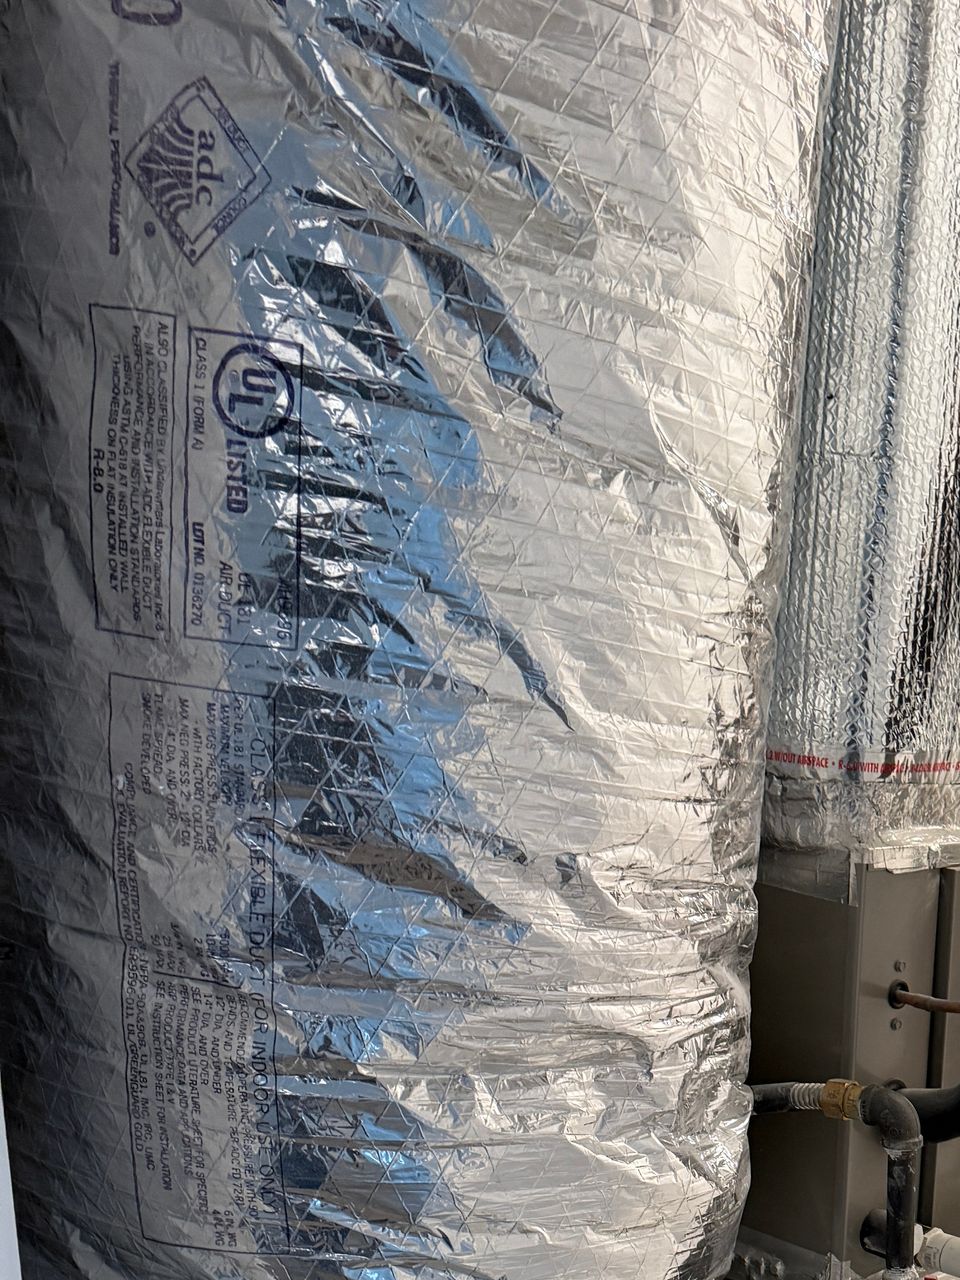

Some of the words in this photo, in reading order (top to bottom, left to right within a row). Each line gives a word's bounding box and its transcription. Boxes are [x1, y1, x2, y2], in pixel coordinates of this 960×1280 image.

[196, 130, 224, 207] adc
[144, 343, 154, 355] IN
[157, 321, 169, 356] ALSO
[195, 337, 207, 379] CLASS
[108, 354, 120, 424] THICKNESS
[123, 355, 133, 395] USING
[132, 325, 144, 426] PERFORMANCE
[228, 368, 276, 414] UL
[144, 358, 156, 448] ACCORDANCE
[156, 360, 169, 435] CLASSIFIED
[121, 400, 131, 433] ASTM
[192, 395, 205, 434] (FORM
[107, 428, 117, 447] ON
[119, 437, 130, 469] C-518
[131, 429, 142, 455] AND
[156, 439, 166, 453] BY
[191, 437, 205, 451] A)
[93, 448, 105, 493] R-8.0
[107, 450, 117, 479] FLAT
[119, 473, 128, 487] AT
[143, 453, 153, 484] WITH
[226, 438, 248, 514] LISTED
[130, 458, 140, 543] INSTALLATION
[142, 487, 153, 512] ADC
[106, 483, 117, 555] INSULATION
[118, 491, 129, 558] INSTALLED
[192, 521, 205, 546] LOT
[141, 516, 153, 573] FLEXIBLE
[108, 559, 119, 592] ONLY
[120, 561, 129, 594] WALL
[130, 548, 141, 623] STANDARDS
[219, 560, 233, 585] AIR
[142, 576, 153, 611] DUCT
[191, 572, 205, 626] 0136270
[217, 591, 233, 635] DUCT
[141, 692, 152, 729] SMOKE
[153, 694, 164, 731] FLAME
[179, 723, 189, 746] NEG
[192, 727, 202, 753] WITH
[140, 733, 152, 795] DEVELOPED
[193, 756, 204, 801] FACTORY
[250, 738, 266, 806] CLASS
[775, 751, 796, 764] W/OUT
[797, 755, 829, 769] AIRSPACE
[860, 762, 879, 774] WITH
[166, 769, 176, 790] AND
[124, 762, 137, 838] COMPLIANCE
[116, 803, 129, 873] EVALUATION
[192, 804, 204, 851] COLLARS
[127, 841, 137, 867] AND
[118, 876, 130, 920] REPORT
[139, 959, 149, 989] NFPA
[249, 931, 266, 986] DUCT
[155, 979, 165, 999] SEE
[191, 986, 201, 1003] SEE
[175, 983, 189, 1057] PERFORMANCE
[225, 994, 236, 1026] BENDS
[248, 992, 269, 1034] (FOR
[152, 1002, 164, 1070] INSTRUCTION
[164, 1004, 176, 1053] PRODUCT
[187, 1007, 200, 1056] PRODUCT
[199, 1034, 210, 1056] AND
[223, 1029, 234, 1051] AND
[139, 1054, 148, 1067] UL
[211, 1036, 221, 1058] AND
[154, 1072, 164, 1102] SHEET
[177, 1061, 188, 1085] DATA
[188, 1059, 201, 1114] LITERATURE
[199, 1059, 210, 1085] OVER
[212, 1060, 223, 1094] UNDER
[252, 1040, 269, 1115] INDOOR
[157, 1105, 167, 1124] FOR
[179, 1088, 189, 1109] AND
[134, 1121, 144, 1152] GOLD
[191, 1118, 203, 1147] SHEET
[230, 1126, 240, 1143] PER
[256, 1121, 274, 1156] USE
[145, 1147, 155, 1171] UMC
[158, 1126, 172, 1191] INSTALLATION
[196, 1150, 206, 1168] FOR
[231, 1146, 241, 1164] ADC
[232, 1167, 242, 1180] FD
[215, 1231, 225, 1246] WG
[227, 1232, 237, 1247] WG
